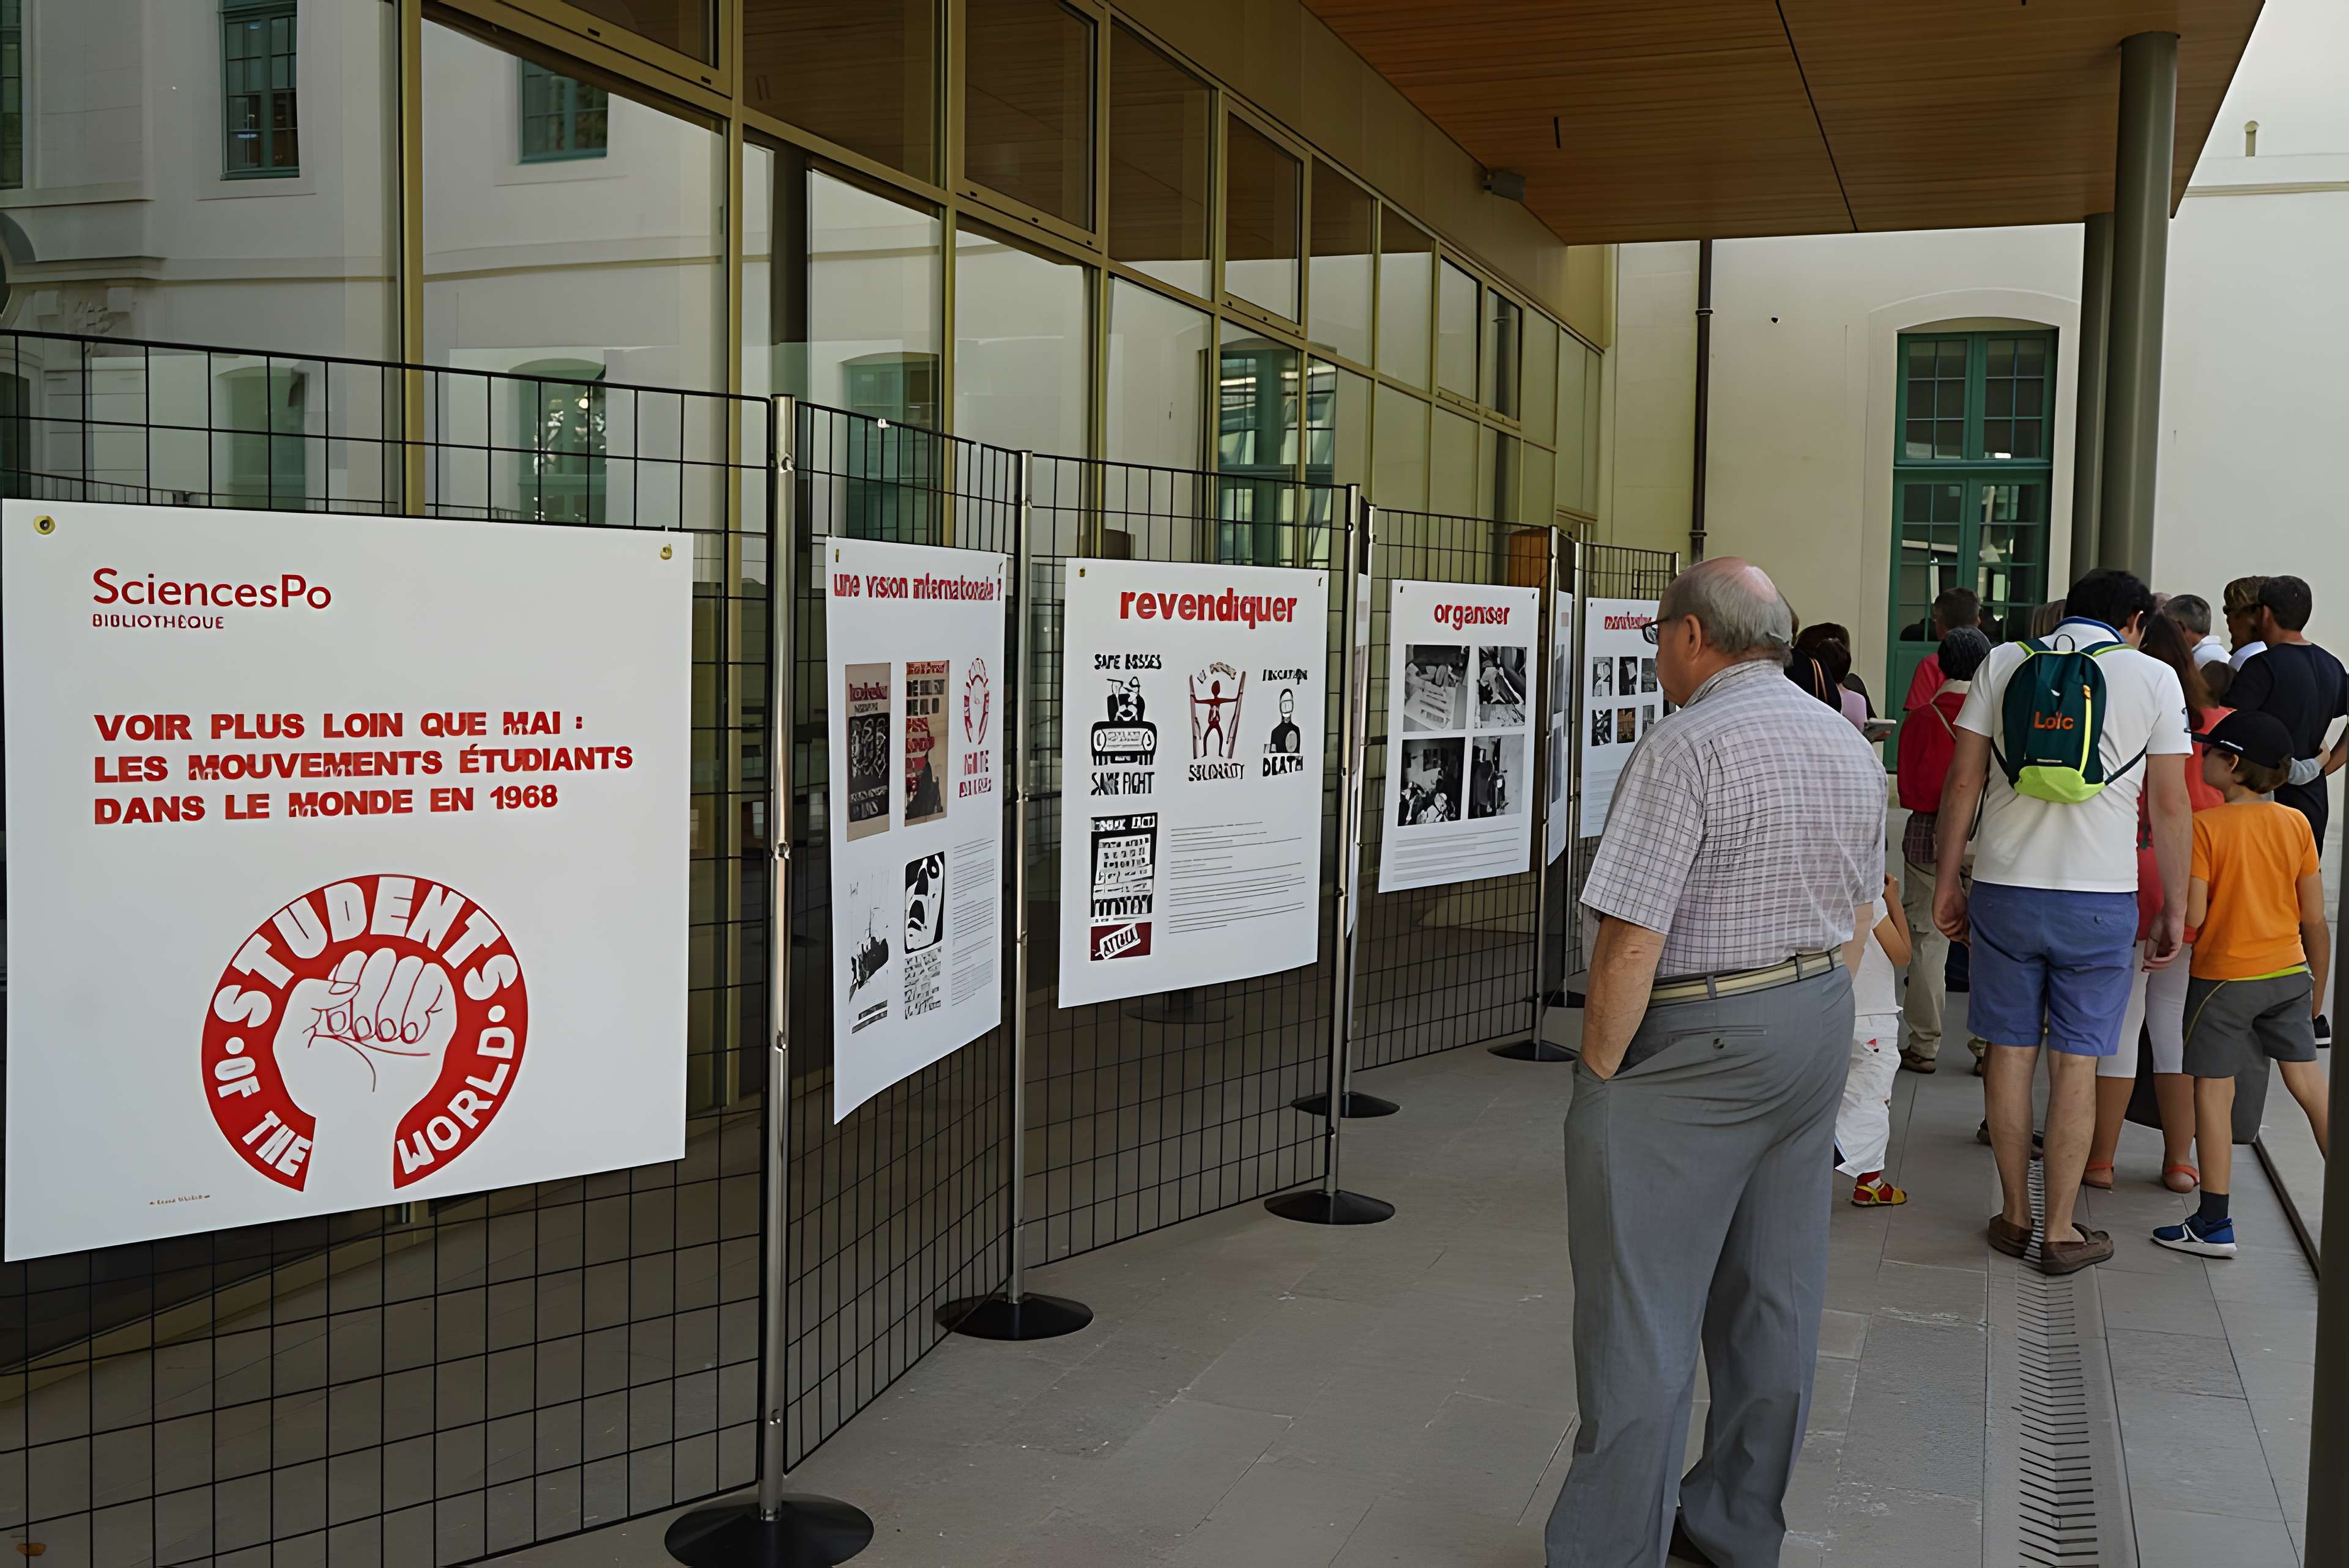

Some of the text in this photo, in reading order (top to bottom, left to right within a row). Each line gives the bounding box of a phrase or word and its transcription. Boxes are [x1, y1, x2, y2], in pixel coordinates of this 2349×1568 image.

[92, 567, 331, 609] SciencesPo
[833, 574, 861, 597] une
[1119, 586, 1297, 630] revendiquer
[94, 714, 192, 742] VOIR
[210, 713, 305, 740] PLUS
[322, 712, 403, 739] LOIN
[420, 711, 488, 738] QUE
[502, 710, 562, 736] MAI
[94, 743, 633, 783] LES MOUVEMENTS ÉTUDIANTS
[94, 783, 558, 825] DANS LE MONDE EN 1968
[213, 876, 519, 1028] STUDENTS
[214, 1026, 515, 1177] OF THE WORLD
